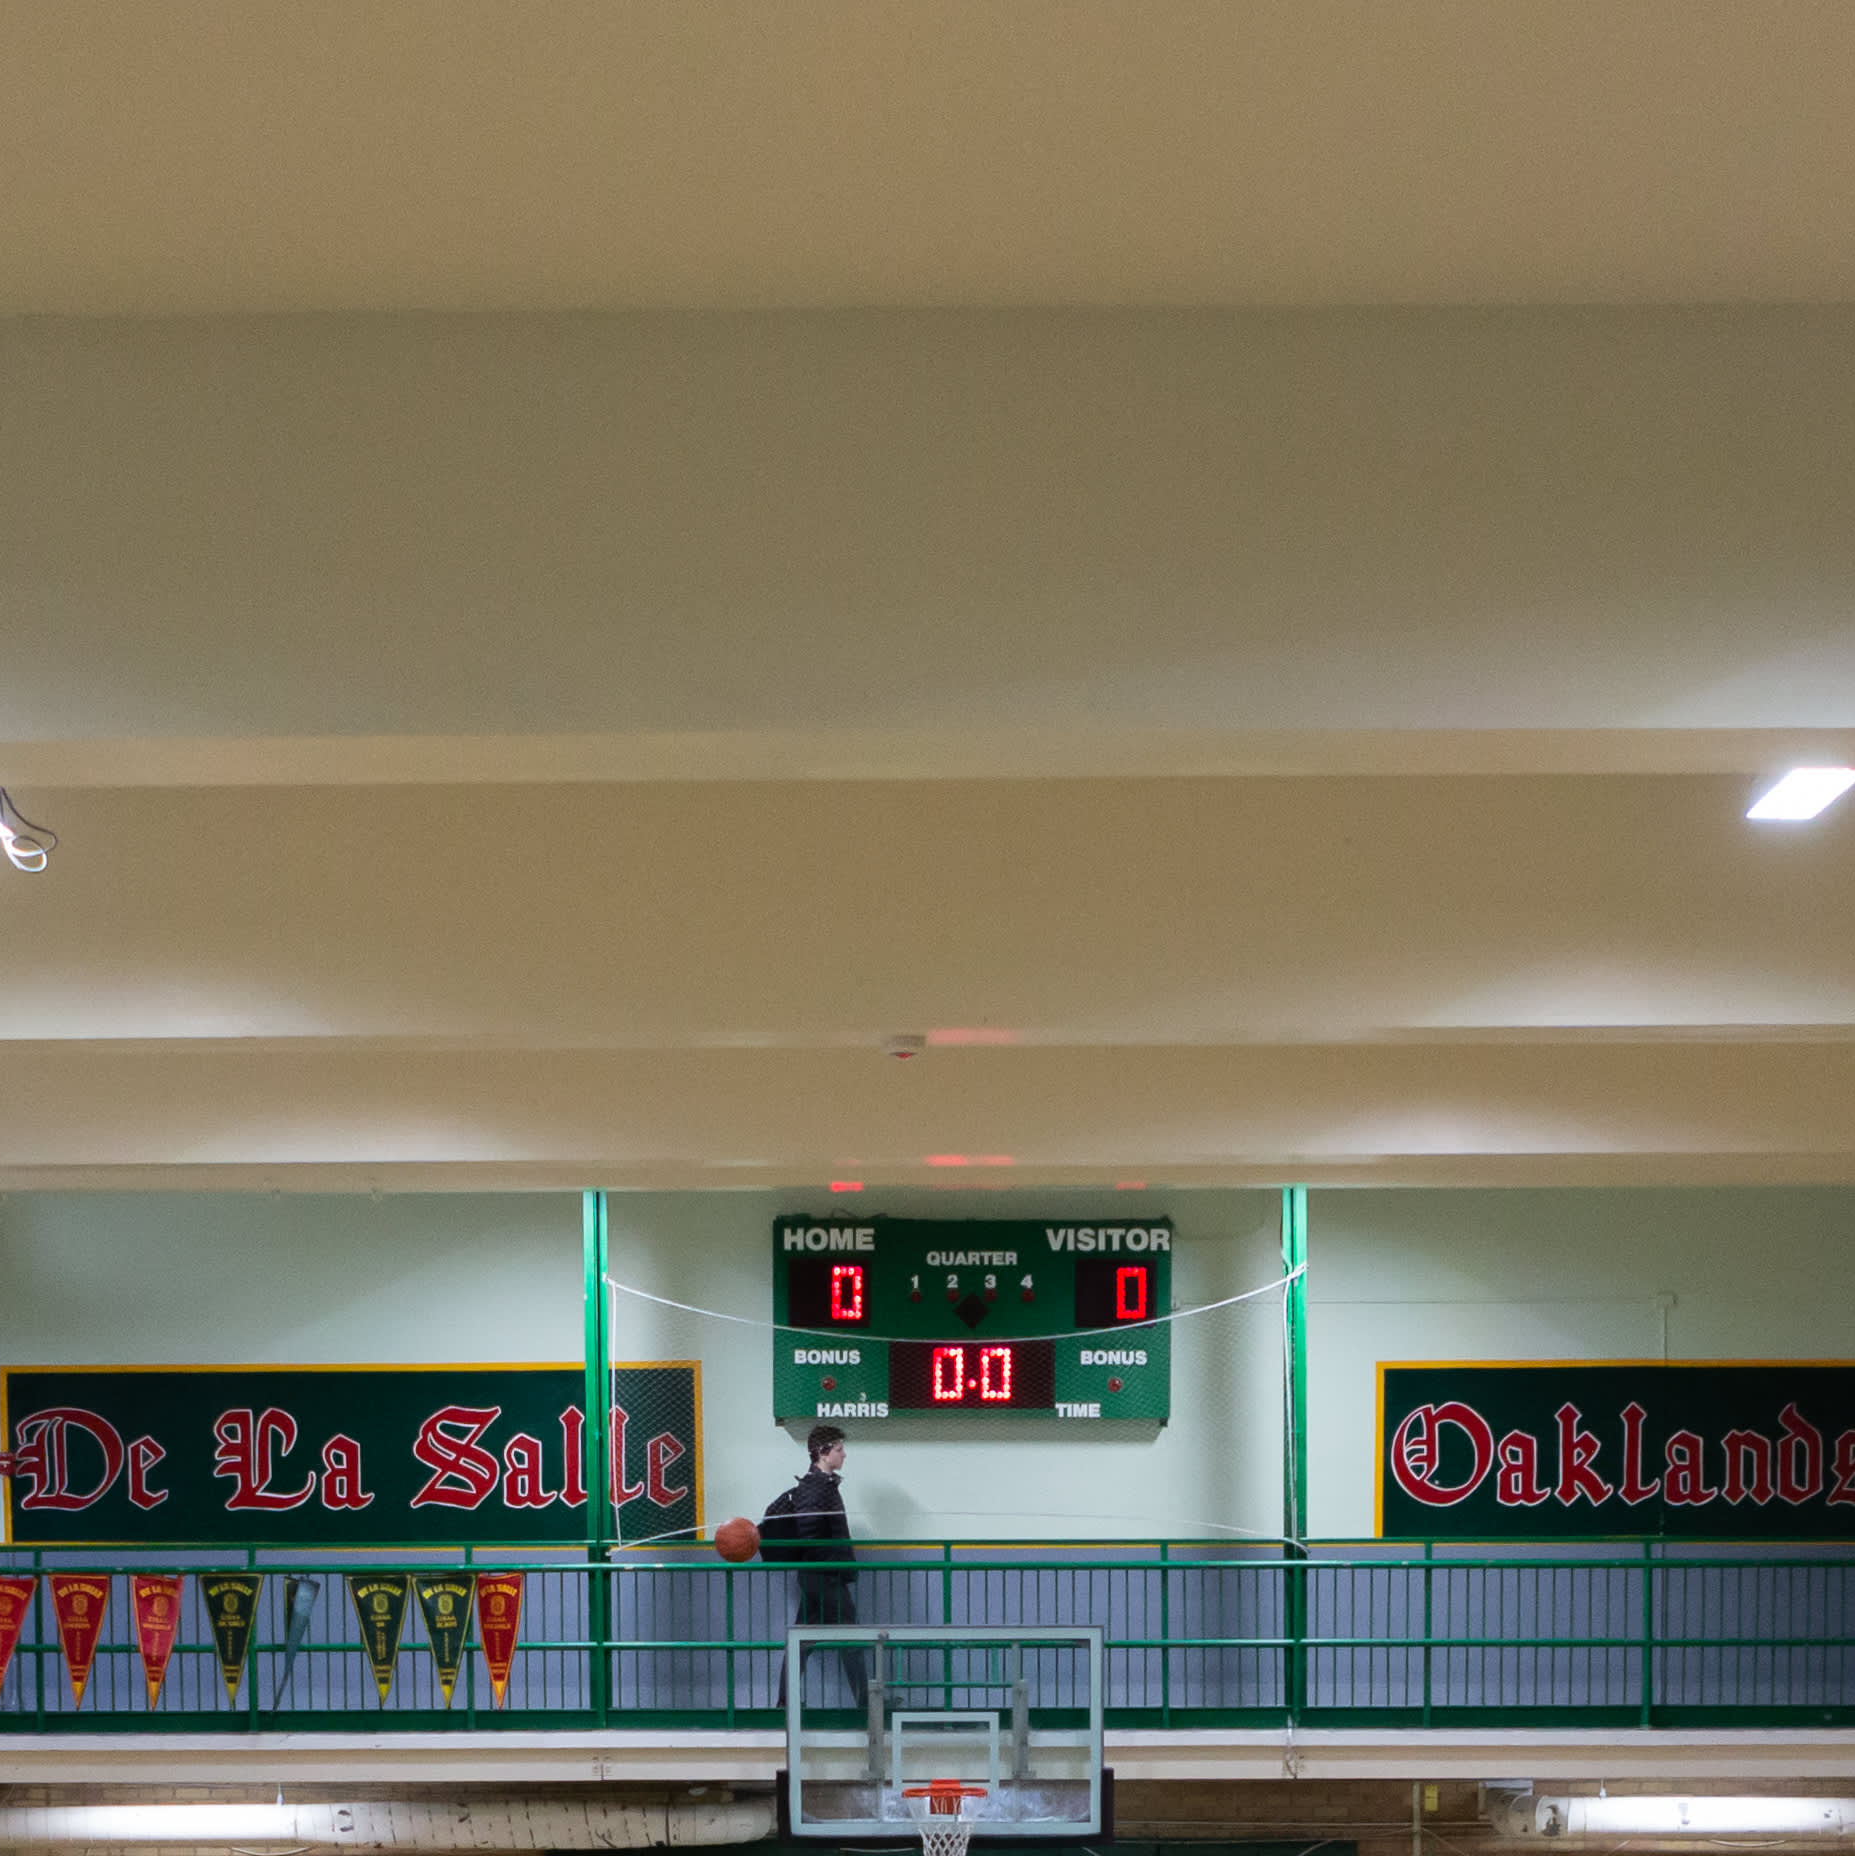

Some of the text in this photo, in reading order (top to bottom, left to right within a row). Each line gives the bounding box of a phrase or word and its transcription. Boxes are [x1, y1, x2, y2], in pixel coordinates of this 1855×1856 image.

[784, 1228, 1170, 1251] HOME VISITOR
[927, 1251, 1017, 1266] QUARTER
[911, 1275, 1033, 1289] 1 2 3 4
[831, 1265, 863, 1320] 0
[1116, 1266, 1146, 1319] 0
[794, 1350, 860, 1365] BONUS
[1080, 1350, 1147, 1366] BONUS
[817, 1403, 888, 1418] HARRIS
[1056, 1403, 1100, 1418] TIME
[16, 1405, 688, 1511] De La Salle
